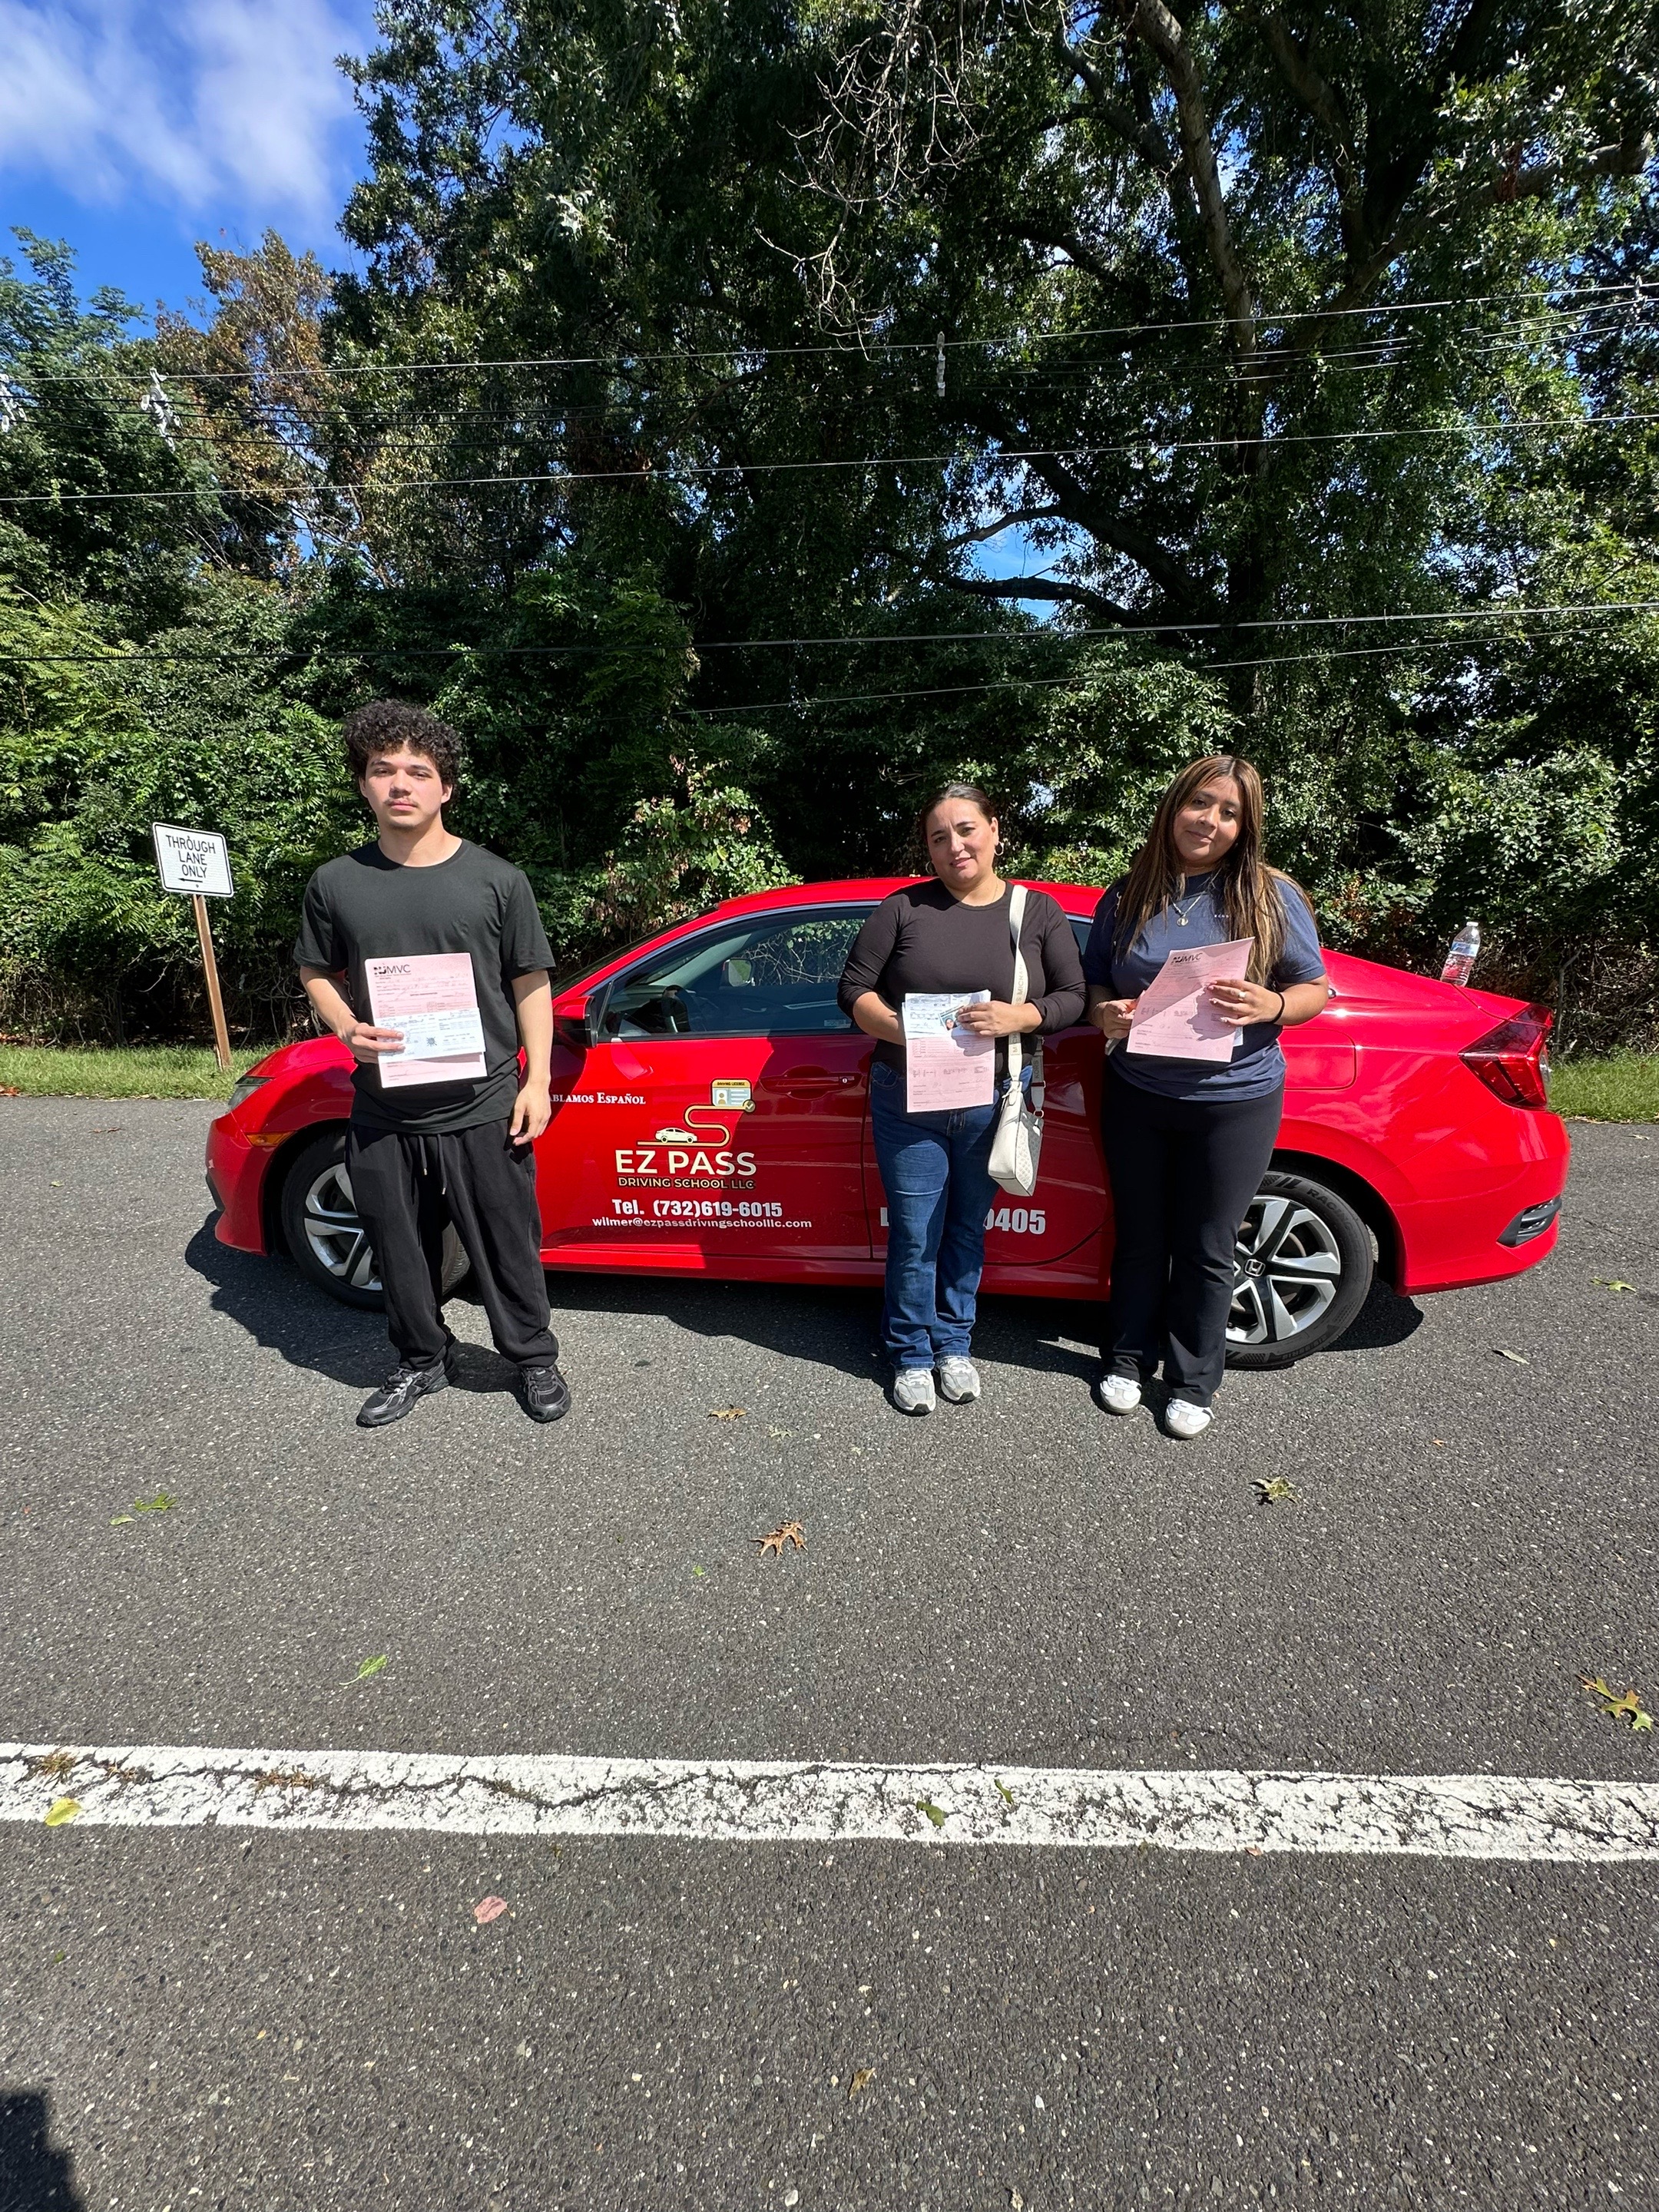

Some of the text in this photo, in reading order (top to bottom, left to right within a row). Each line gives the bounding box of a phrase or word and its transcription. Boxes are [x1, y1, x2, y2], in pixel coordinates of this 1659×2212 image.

[165, 834, 216, 854] THROUGH
[178, 850, 207, 866] LANE
[181, 864, 207, 878] ONLY
[550, 1094, 594, 1103] BLAMOS
[615, 1149, 757, 1176] EZ PASS
[618, 1177, 755, 1189] DRIVING SCHOOL LLC
[611, 1198, 783, 1217] Tel. (732)619-6015
[592, 1217, 812, 1229] wilmer@ezpassdrivingschoolllc.com
